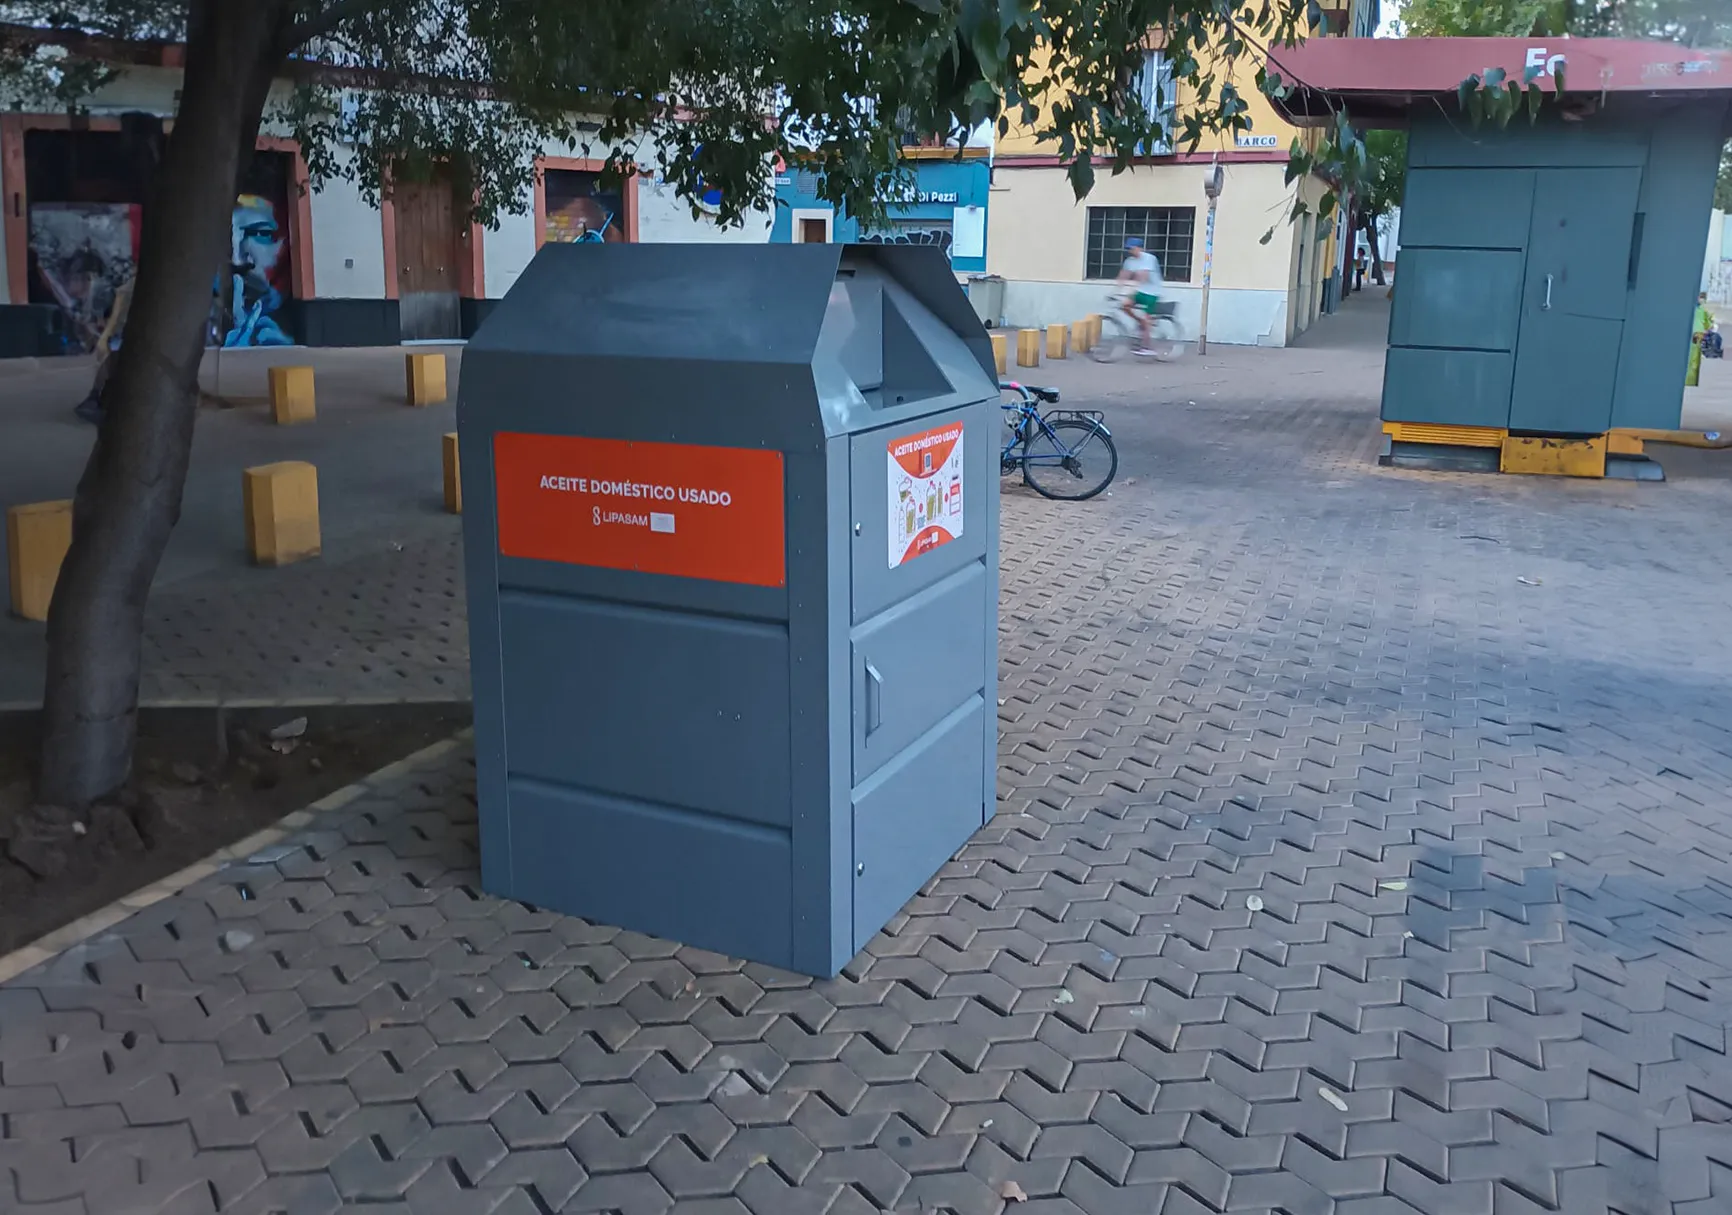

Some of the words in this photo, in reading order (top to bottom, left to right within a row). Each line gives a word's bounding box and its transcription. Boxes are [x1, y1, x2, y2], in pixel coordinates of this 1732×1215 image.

[540, 475, 587, 492] ACEITE
[591, 480, 675, 501] DOMÉSTICO
[679, 488, 732, 506] USADO
[603, 511, 648, 526] LIPASAM
